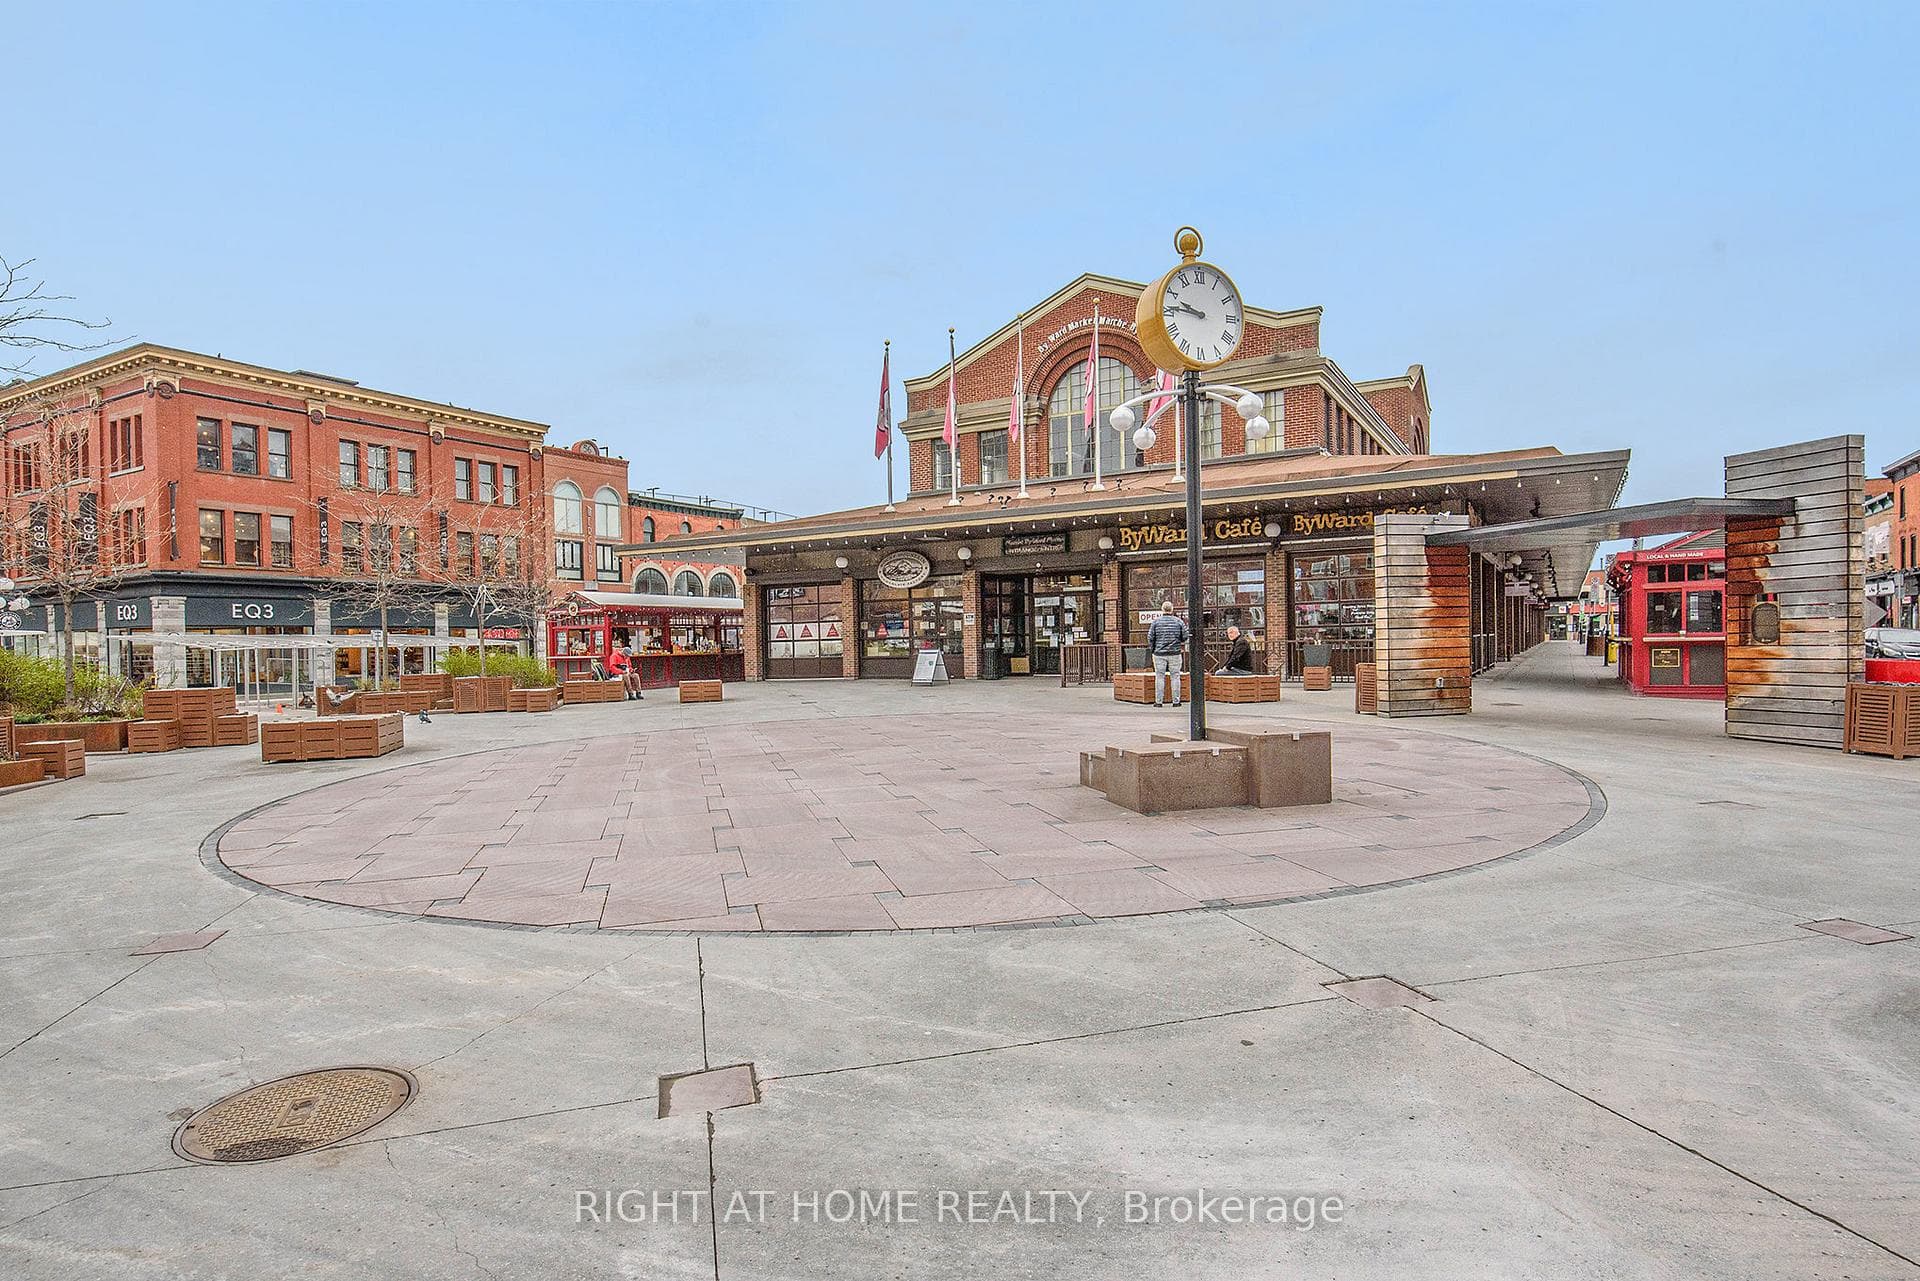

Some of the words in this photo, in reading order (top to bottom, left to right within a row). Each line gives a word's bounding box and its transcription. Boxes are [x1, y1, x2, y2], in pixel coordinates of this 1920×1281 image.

[1193, 271, 1205, 284] XII
[1037, 342, 1049, 353] By
[1048, 326, 1067, 342] Ward
[83, 517, 96, 540] EQ3
[1120, 522, 1207, 551] ByWar
[1215, 518, 1262, 539] Café
[1294, 511, 1374, 535] ByWard
[33, 525, 46, 548] EQ3
[117, 604, 138, 621] EQ3
[231, 603, 274, 619] EQ3
